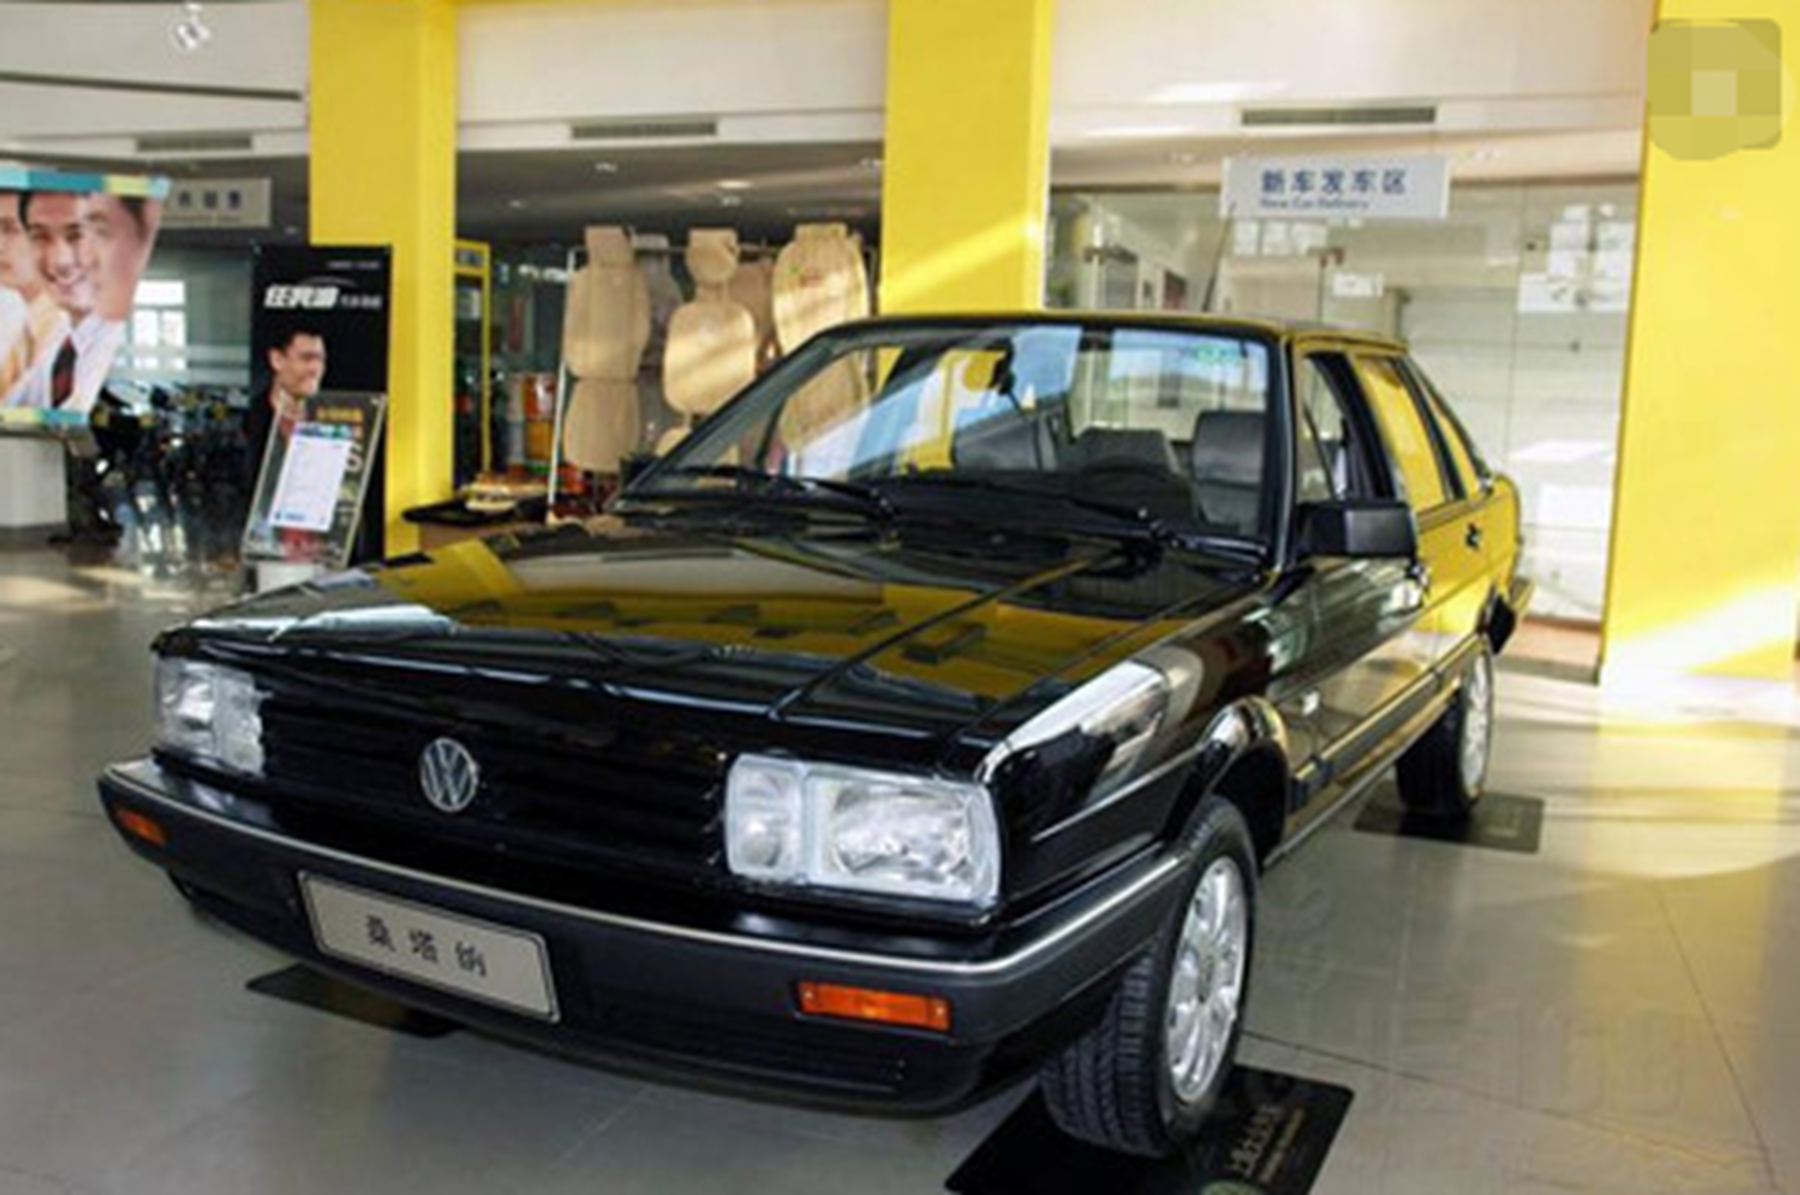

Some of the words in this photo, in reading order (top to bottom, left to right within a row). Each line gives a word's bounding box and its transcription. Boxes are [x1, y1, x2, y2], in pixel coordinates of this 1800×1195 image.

[1261, 170, 1407, 195] 新车发车区
[421, 737, 479, 812] VW
[366, 914, 487, 977] 桑塔纳
